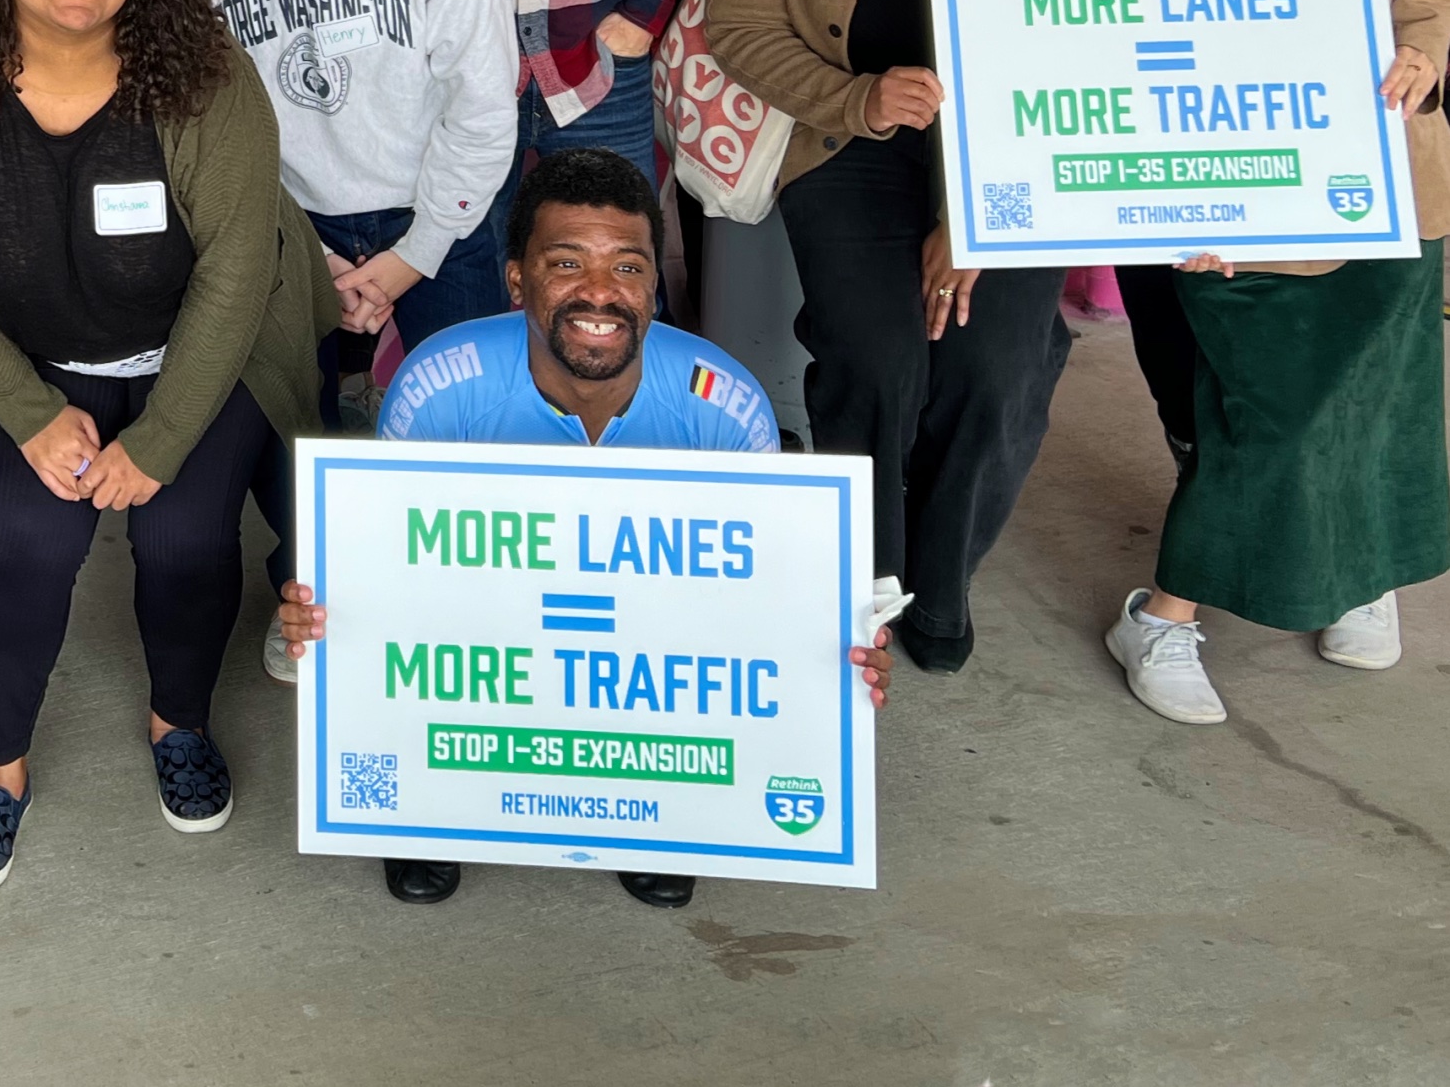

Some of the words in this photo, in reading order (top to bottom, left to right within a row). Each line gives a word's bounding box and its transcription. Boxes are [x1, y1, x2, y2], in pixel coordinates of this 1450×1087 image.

[320, 26, 366, 45] Henry
[1012, 87, 1137, 137] MORE
[1149, 82, 1330, 134] TRAFFIC
[1058, 159, 1112, 186] STOP
[1118, 158, 1166, 184] I-35
[1173, 154, 1298, 183] EXPANSION!
[1117, 203, 1247, 225] RETHINK35.COM
[1335, 192, 1368, 212] 35
[406, 507, 556, 571] MORE
[578, 514, 754, 579] LANES
[385, 642, 534, 705] MORE
[553, 649, 779, 718] TRAFFIC
[433, 731, 498, 764] STOP
[506, 734, 564, 767] I-35
[573, 738, 728, 776] EXPANSION!
[770, 778, 819, 791] Rethink
[501, 792, 659, 823] RETHINK35.COM
[775, 797, 815, 824] 35
